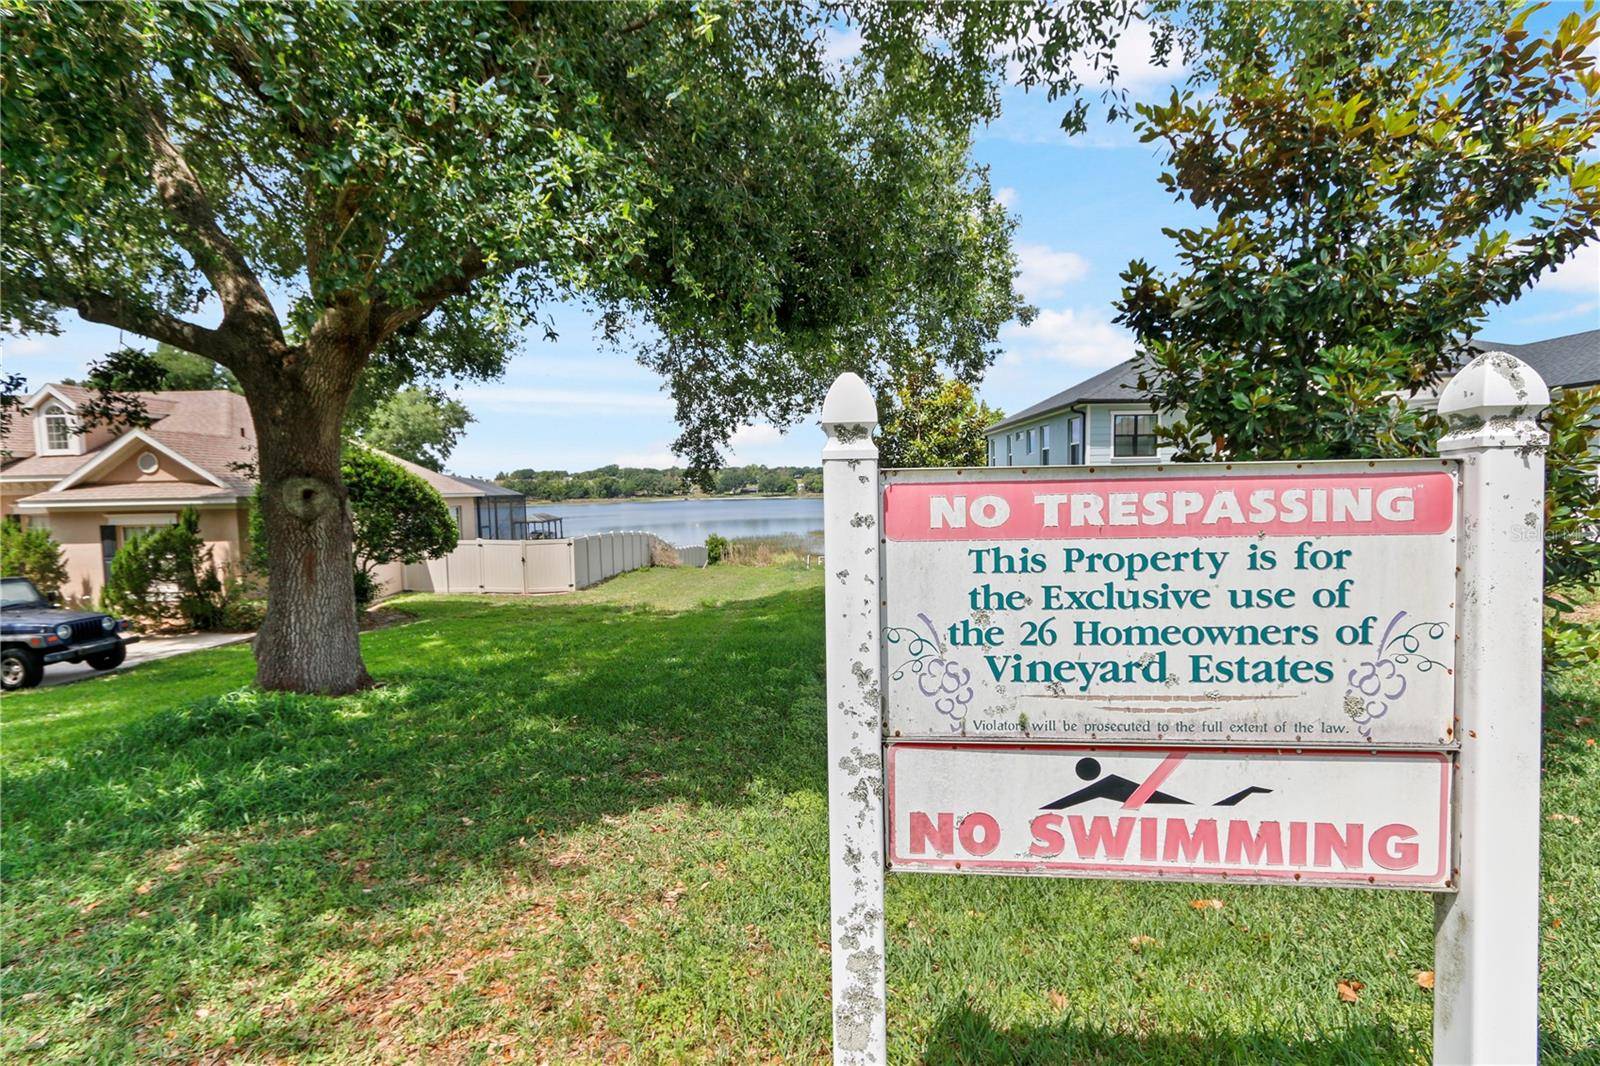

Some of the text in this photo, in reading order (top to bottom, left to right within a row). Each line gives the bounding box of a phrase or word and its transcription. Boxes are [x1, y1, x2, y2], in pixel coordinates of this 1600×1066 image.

[930, 488, 1415, 528] NO TRESPASSING
[968, 541, 1352, 580] This Property is for
[968, 579, 1354, 611] the Exclusive use of
[948, 616, 1378, 647] the 26 Homeowners of
[984, 650, 1335, 692] Vineyard Estates
[973, 719, 1350, 734] Violators will be prosecuted to the full extent of the law.
[909, 811, 1419, 871] NO SWIMMING
